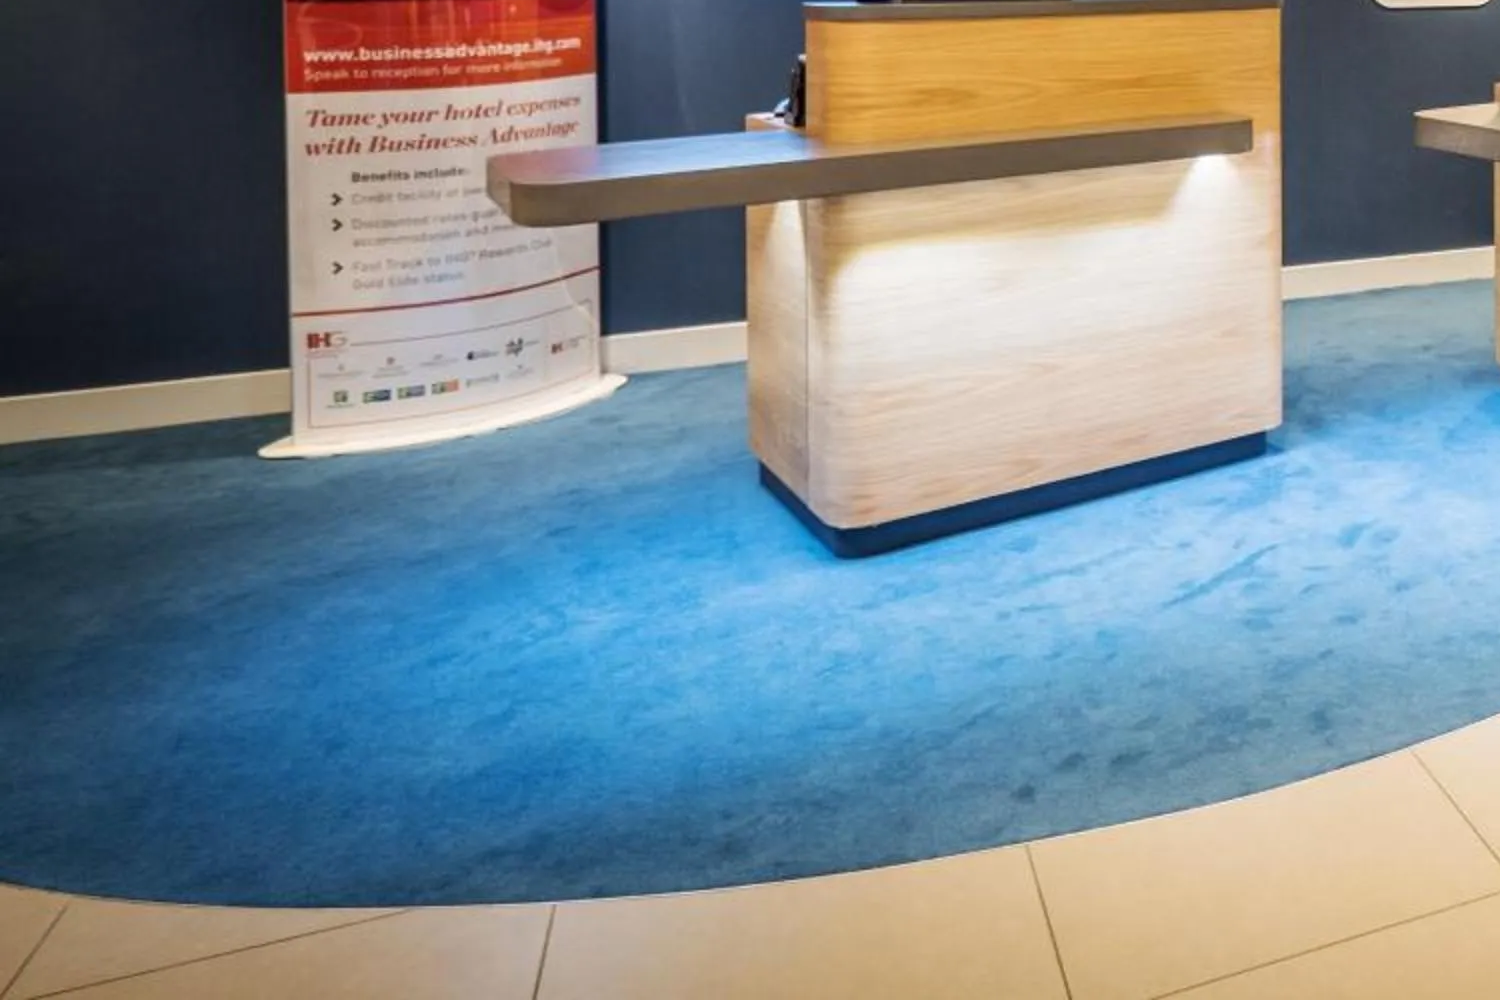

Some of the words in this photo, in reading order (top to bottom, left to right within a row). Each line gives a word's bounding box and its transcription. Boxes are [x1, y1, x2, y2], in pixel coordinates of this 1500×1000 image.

[303, 37, 581, 62] www.businessadvantage.ihg.com
[303, 67, 349, 83] Speak
[353, 68, 368, 79] to
[372, 64, 438, 80] reception
[442, 63, 461, 76] for
[465, 62, 500, 75] more
[305, 107, 377, 129] Tame
[378, 108, 439, 129] your
[444, 98, 504, 122] hotel
[506, 95, 581, 117] expenses
[304, 136, 363, 157] with
[368, 131, 479, 154] Business
[480, 120, 580, 147] Advantage
[351, 169, 410, 184] Benefits
